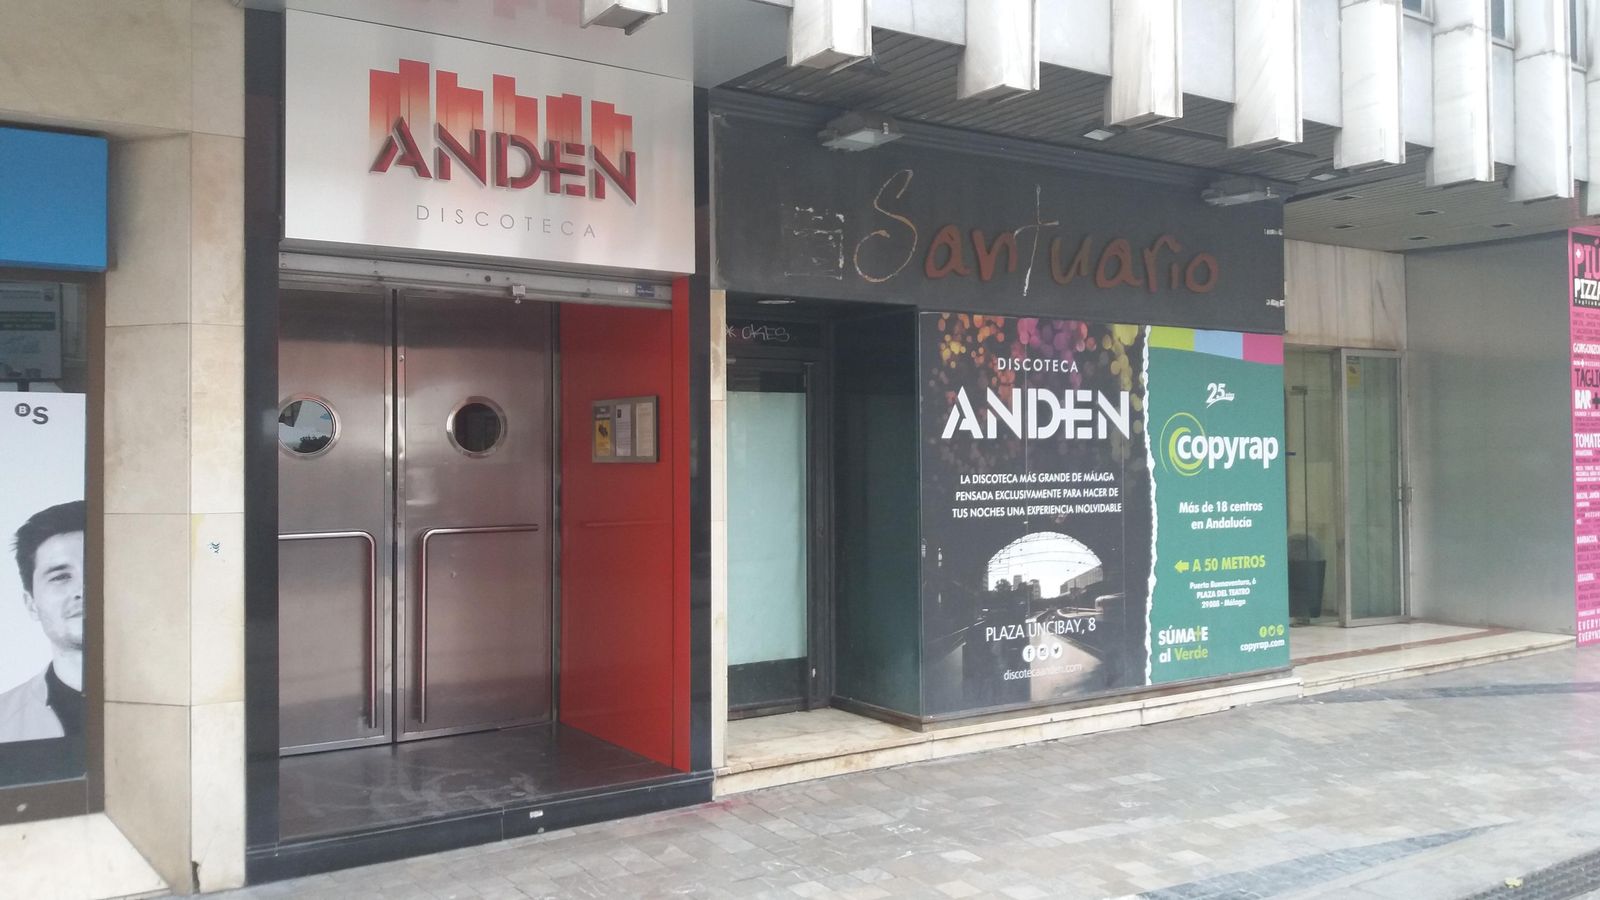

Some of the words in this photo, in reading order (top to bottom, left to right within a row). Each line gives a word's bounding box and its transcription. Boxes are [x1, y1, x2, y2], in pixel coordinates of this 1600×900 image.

[369, 116, 637, 205] ANDEN
[416, 205, 597, 239] DISCOTECA
[854, 169, 1218, 296] Santuario
[997, 357, 1079, 373] DISCOTECA
[1575, 368, 1600, 387] TAGLI
[1206, 383, 1226, 404] 25
[1575, 390, 1592, 410] BAR
[941, 385, 1130, 440] ANDEN
[1177, 435, 1279, 470] copyrap
[960, 474, 971, 485] LA
[972, 473, 1018, 484] DISCOTECA
[1020, 471, 1037, 483] MÁS
[1038, 472, 1071, 482] GRANDE
[1072, 472, 1082, 482] DE
[1083, 470, 1115, 482] MÁLAGA
[955, 490, 994, 501] PENSADA
[995, 489, 1062, 500] EXCLUSIVAMENTE
[1063, 488, 1082, 498] PARA
[1083, 488, 1108, 498] HACER
[1108, 487, 1119, 497] DE
[952, 508, 969, 518] TUS
[970, 506, 1006, 518] NOCHES
[1007, 506, 1025, 516] UNA
[1027, 504, 1074, 515] EXPERIENCIA
[1075, 502, 1122, 514] INOLVIDABLE
[1179, 502, 1199, 514] Más
[1202, 501, 1214, 513] de
[1216, 501, 1228, 512] 18
[1230, 501, 1263, 512] centros
[1191, 520, 1204, 530] en
[1206, 516, 1252, 529] Andalucía
[1192, 559, 1202, 572] A
[1204, 557, 1218, 572] 50
[1221, 555, 1266, 571] METROS
[1252, 577, 1257, 585] 6
[1196, 589, 1217, 599] PLAZA
[1217, 589, 1228, 598] DEL
[1228, 587, 1251, 597] TEATRO
[986, 624, 1025, 641] PLAZA
[1029, 618, 1085, 638] UNCIBAY,
[1088, 617, 1097, 632] 8
[1159, 648, 1171, 663] al
[1174, 645, 1209, 661] Verde
[1240, 639, 1285, 652] copyrap.com
